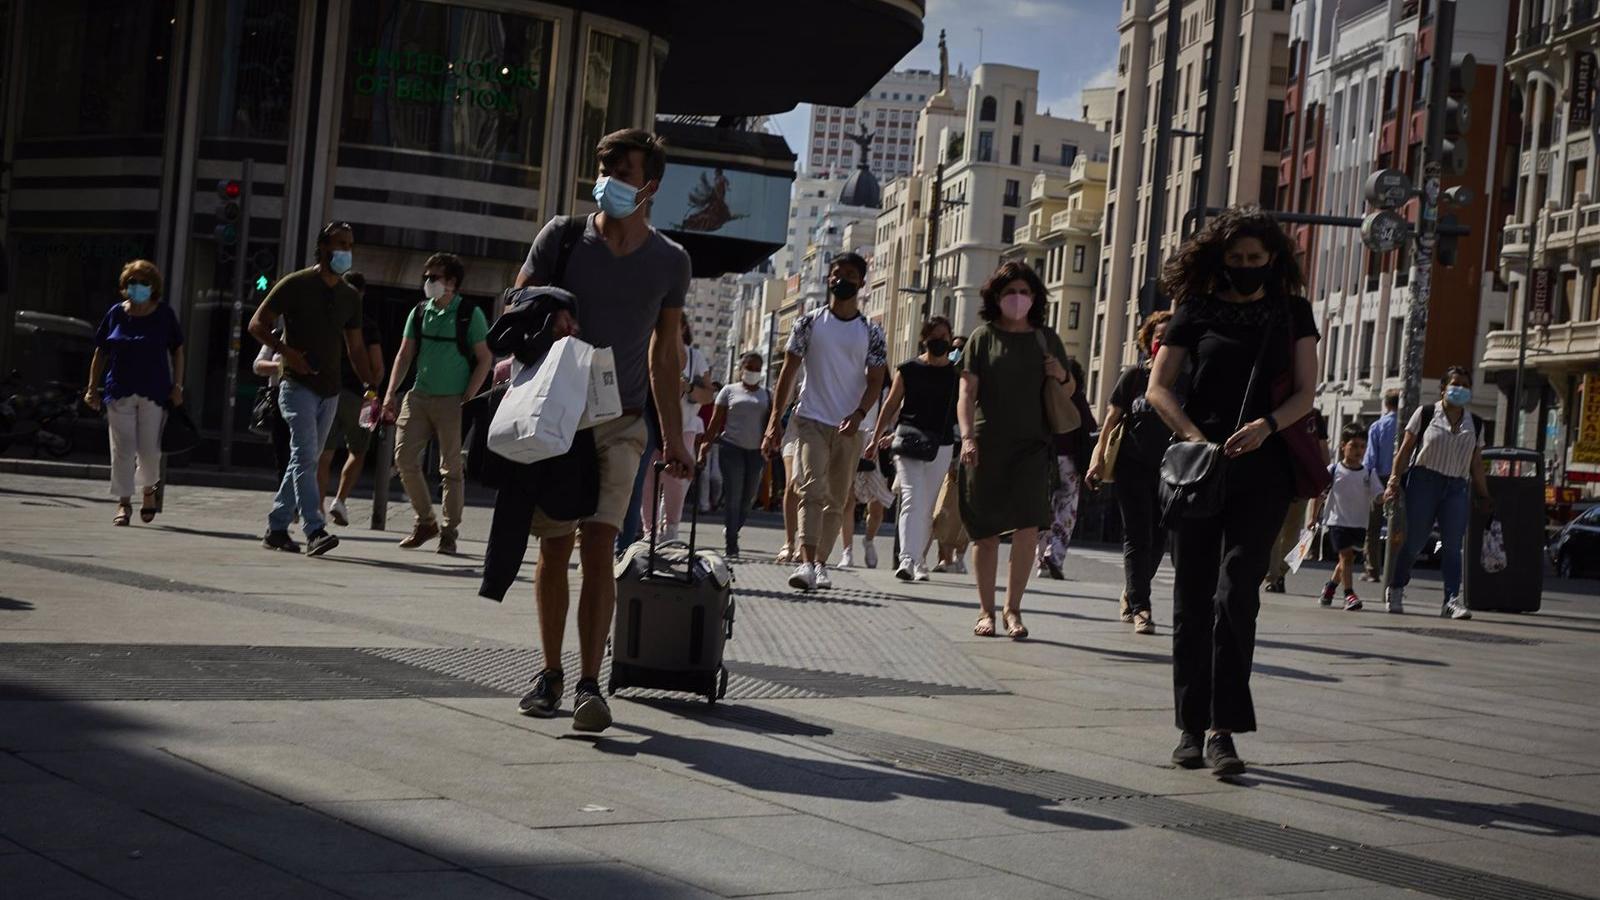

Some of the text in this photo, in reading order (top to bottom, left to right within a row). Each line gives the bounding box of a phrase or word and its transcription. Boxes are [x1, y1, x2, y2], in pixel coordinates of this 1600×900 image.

[355, 48, 540, 90] UNITED COLORS
[355, 74, 388, 96] OF
[1577, 55, 1590, 108] LAURIA
